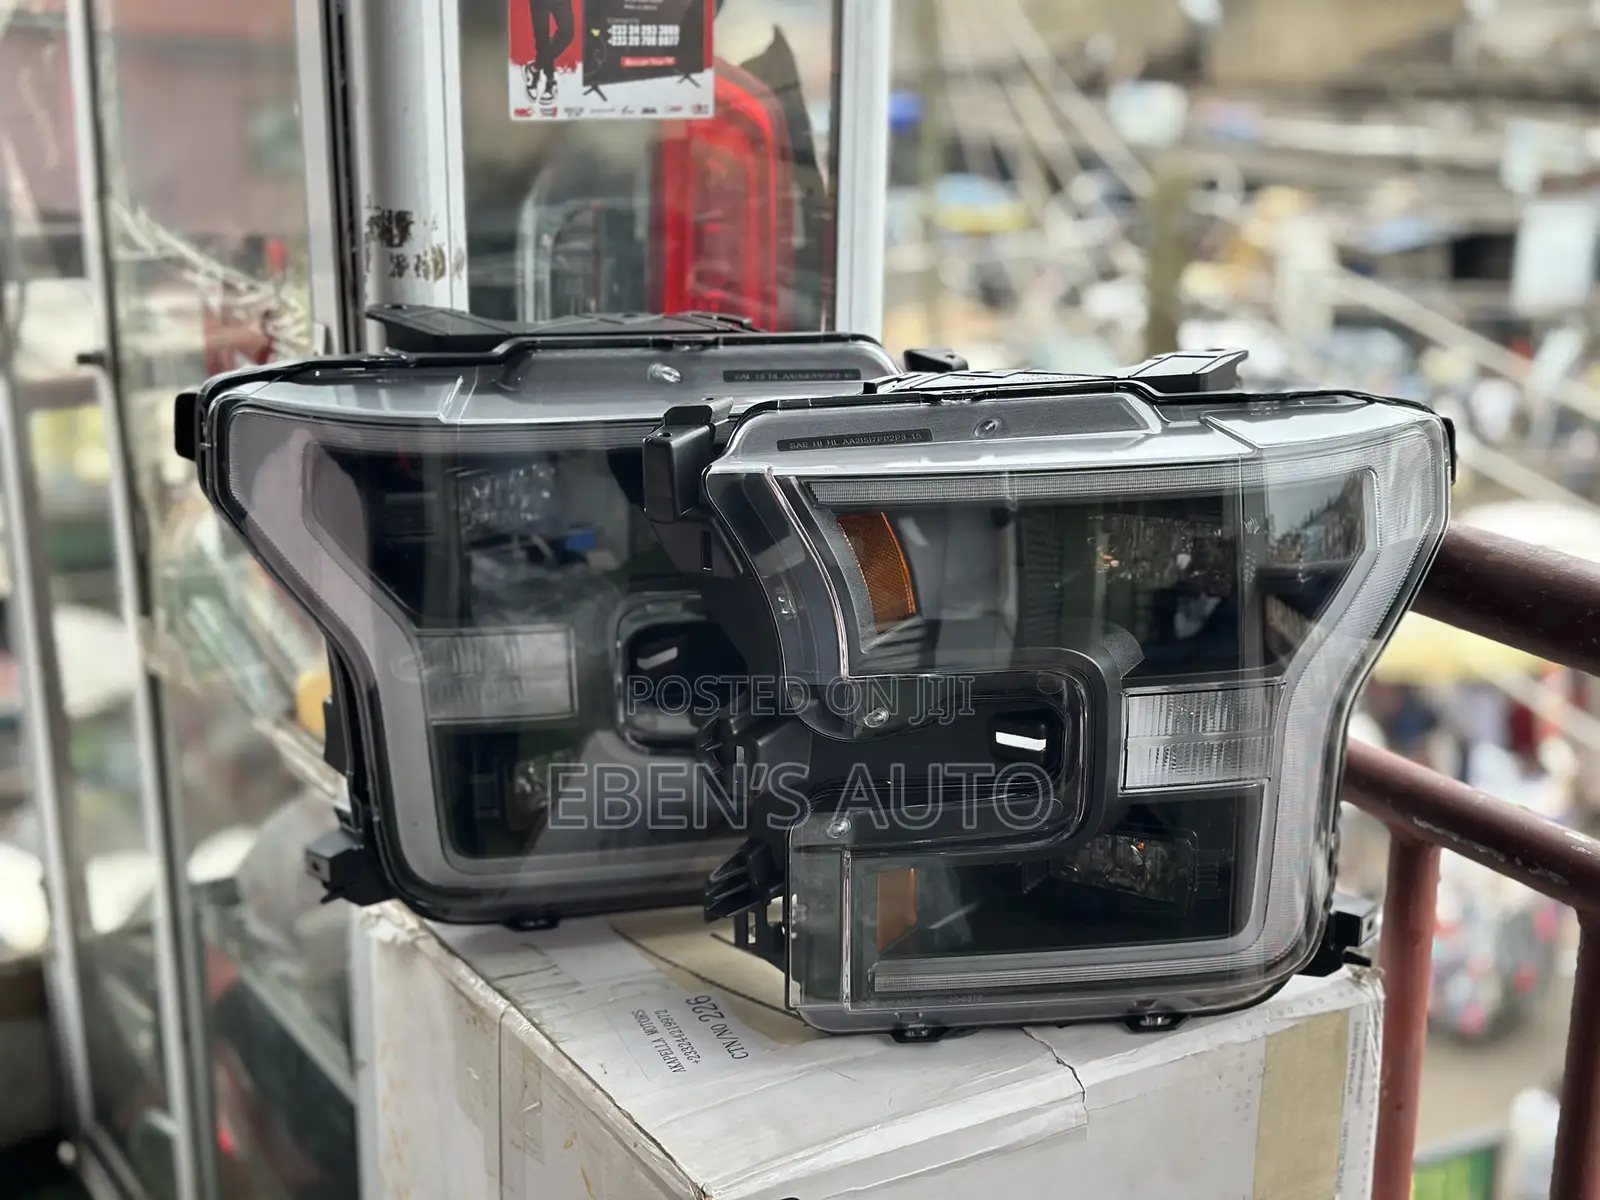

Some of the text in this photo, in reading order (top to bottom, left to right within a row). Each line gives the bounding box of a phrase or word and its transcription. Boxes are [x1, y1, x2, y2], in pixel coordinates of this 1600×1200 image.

[789, 440, 809, 449] SAE
[631, 1009, 687, 1073] AKAPELLA MOTORS
[685, 994, 750, 1060] CTN/NO 226
